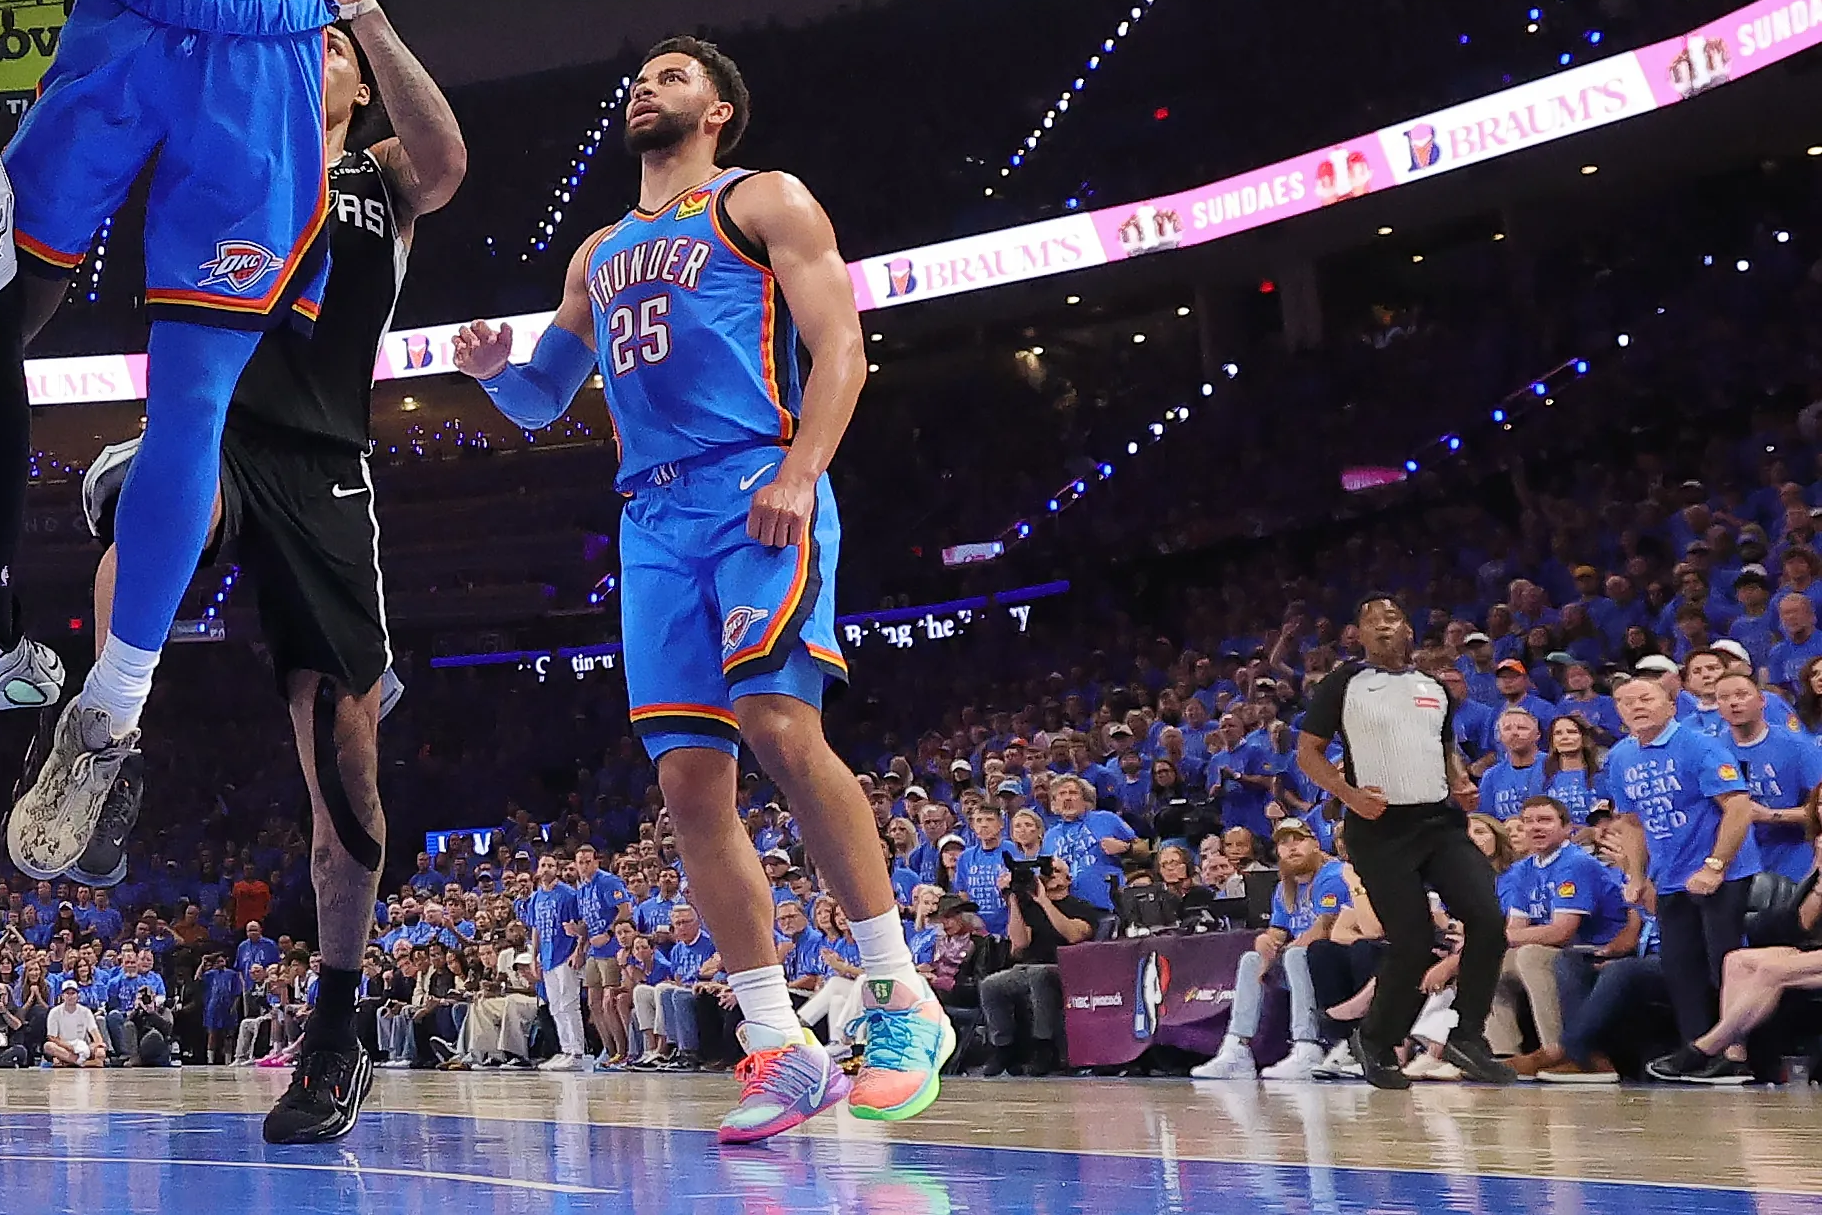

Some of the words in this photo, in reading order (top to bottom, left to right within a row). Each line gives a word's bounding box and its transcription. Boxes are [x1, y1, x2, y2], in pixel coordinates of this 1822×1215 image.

[1446, 76, 1629, 160] BRAUM'S
[1191, 170, 1305, 229] SUNDAES
[588, 236, 714, 314] THUNDER
[923, 233, 1084, 292] BRAUM'S
[608, 291, 673, 378] 25
[28, 370, 116, 398] AUM'S
